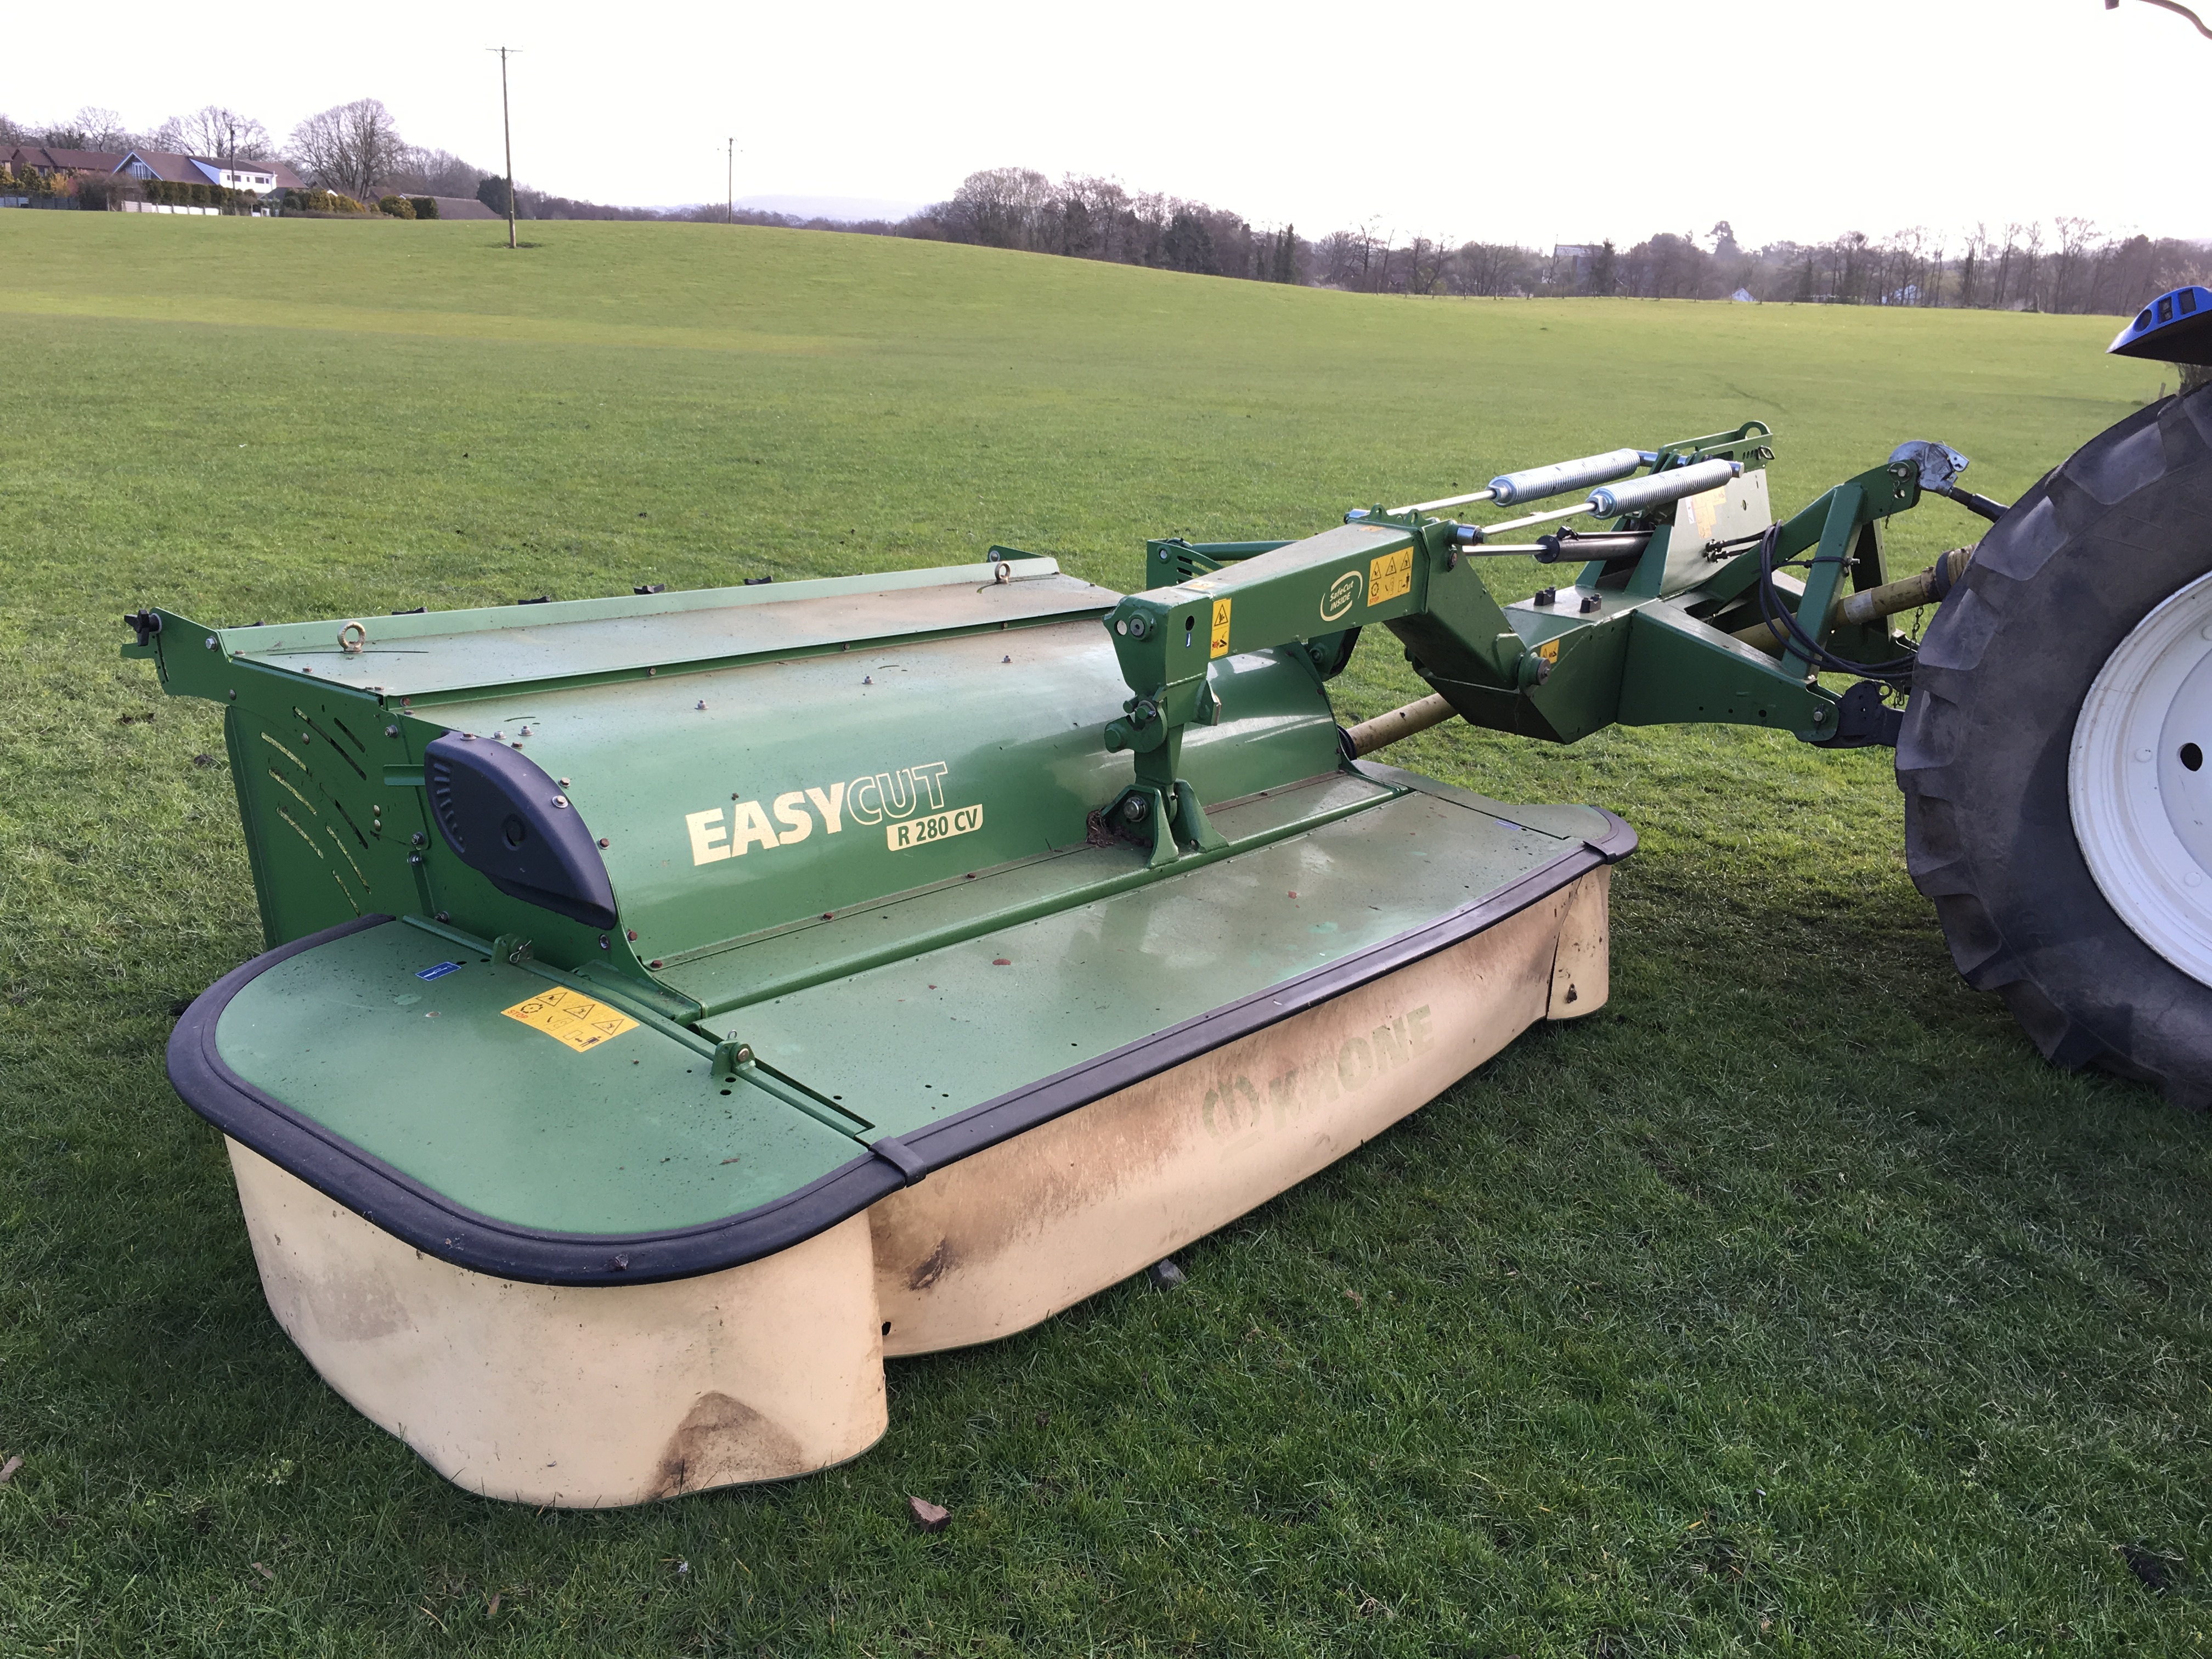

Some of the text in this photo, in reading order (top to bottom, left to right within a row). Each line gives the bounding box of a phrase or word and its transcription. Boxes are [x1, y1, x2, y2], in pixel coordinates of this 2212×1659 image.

[1329, 580, 1354, 602] SafeCut
[1330, 591, 1351, 612] INSIDE
[1369, 596, 1379, 605] STOP
[685, 761, 948, 865] EASYCUT
[898, 808, 978, 847] R 280 CV
[507, 1009, 528, 1019] STOP
